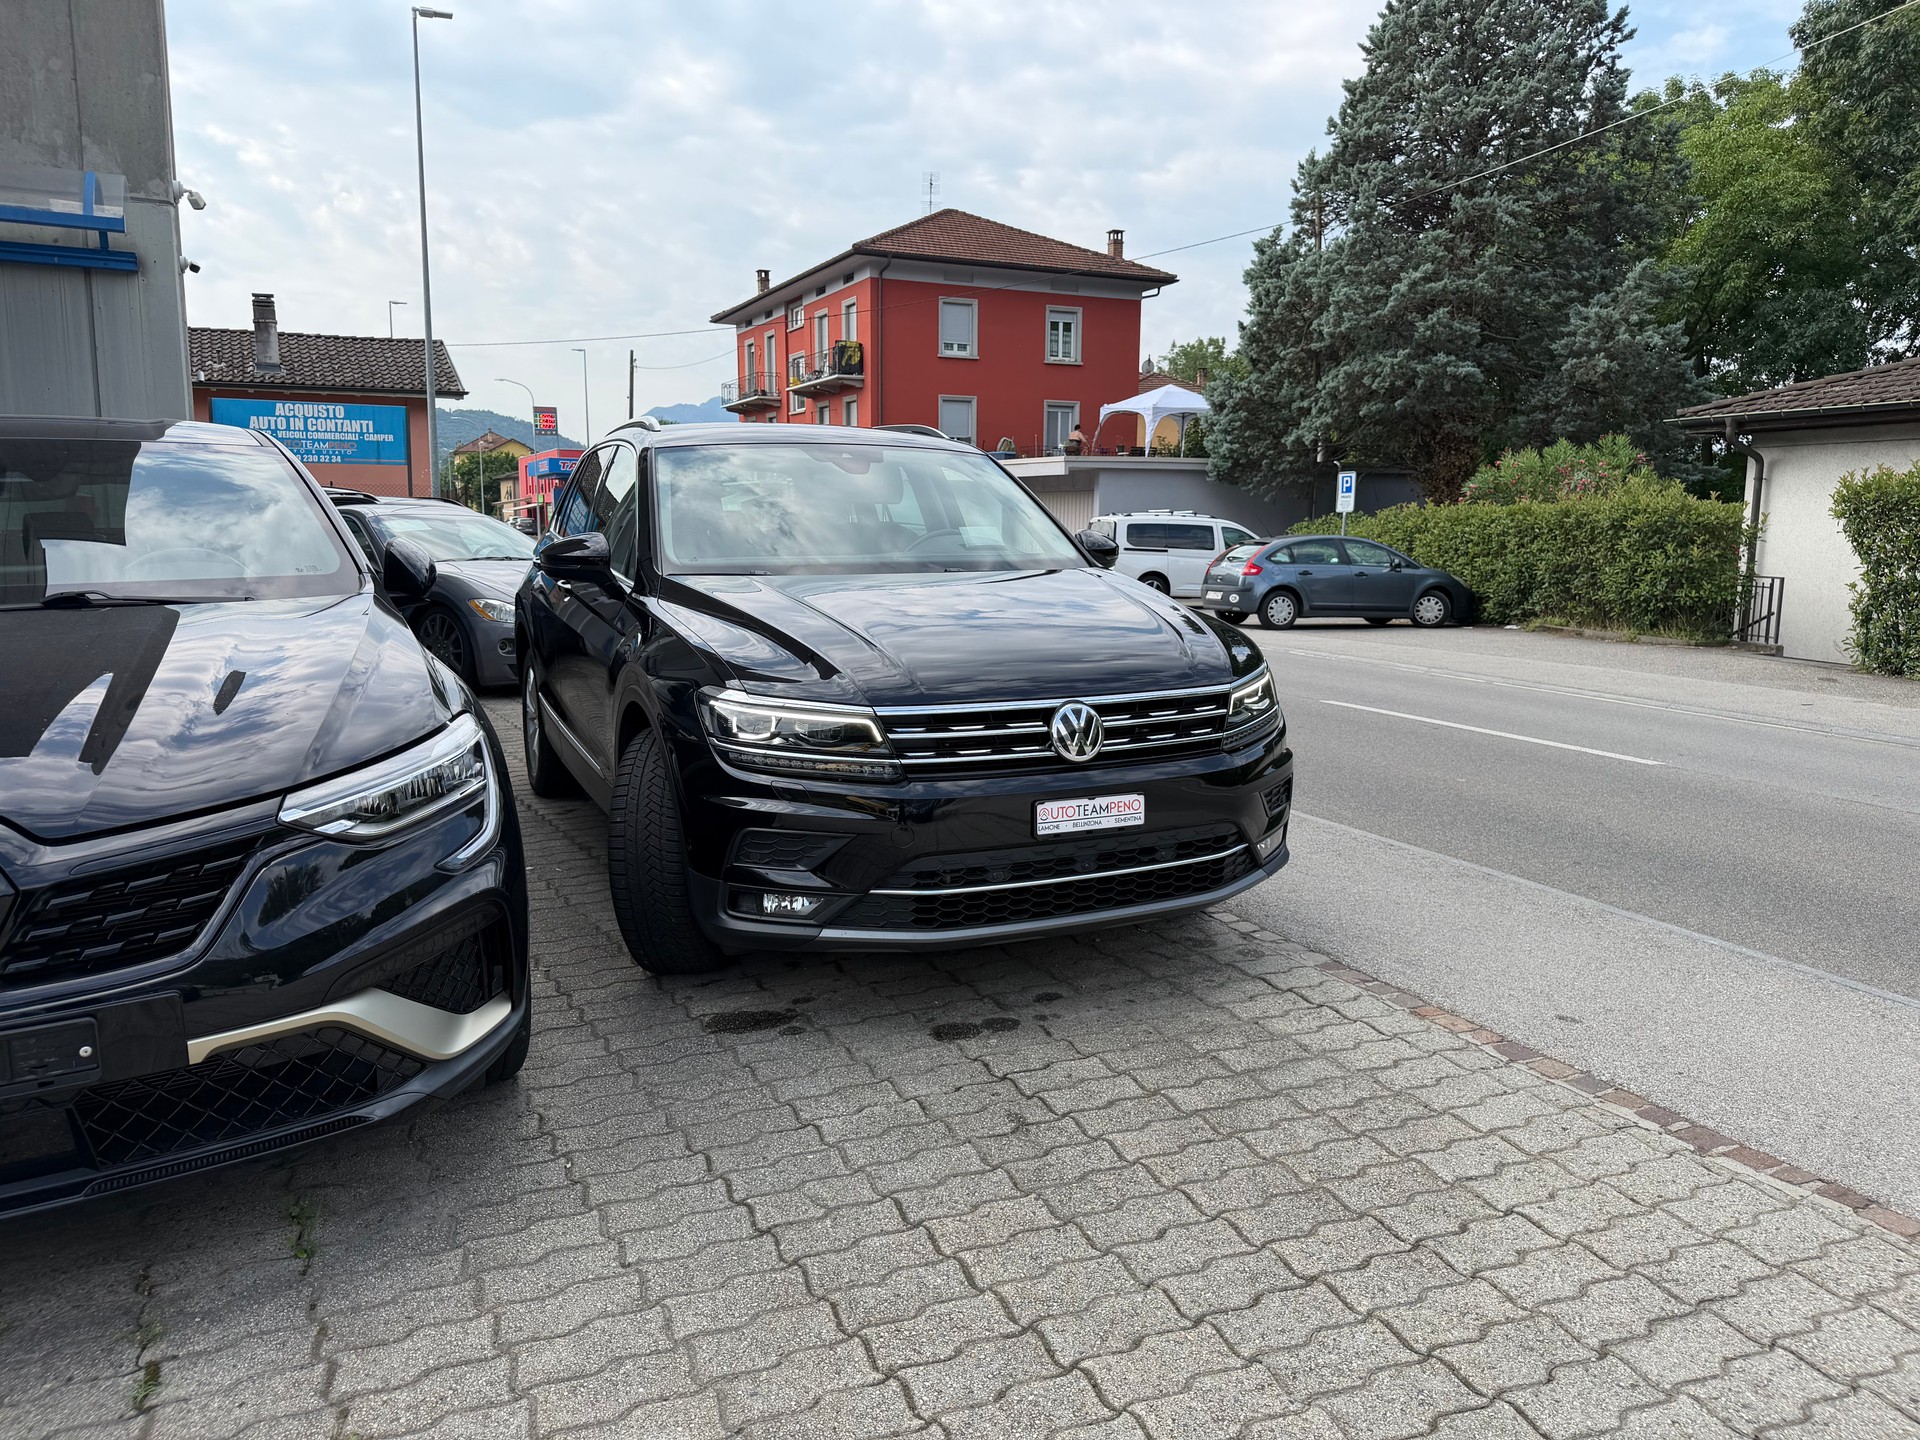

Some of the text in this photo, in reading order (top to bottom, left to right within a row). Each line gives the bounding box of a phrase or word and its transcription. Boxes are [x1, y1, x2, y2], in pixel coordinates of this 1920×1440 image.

[275, 402, 345, 419] ACQUISTO
[249, 416, 374, 433] AUTO IN CONTANTI
[277, 430, 307, 439] VEICOLI
[308, 431, 359, 441] COMMERCIALI
[364, 434, 394, 442] CAMPER
[331, 455, 341, 463] 34
[1038, 815, 1142, 832] LAMONE BELLINZONA SEMENTINA
